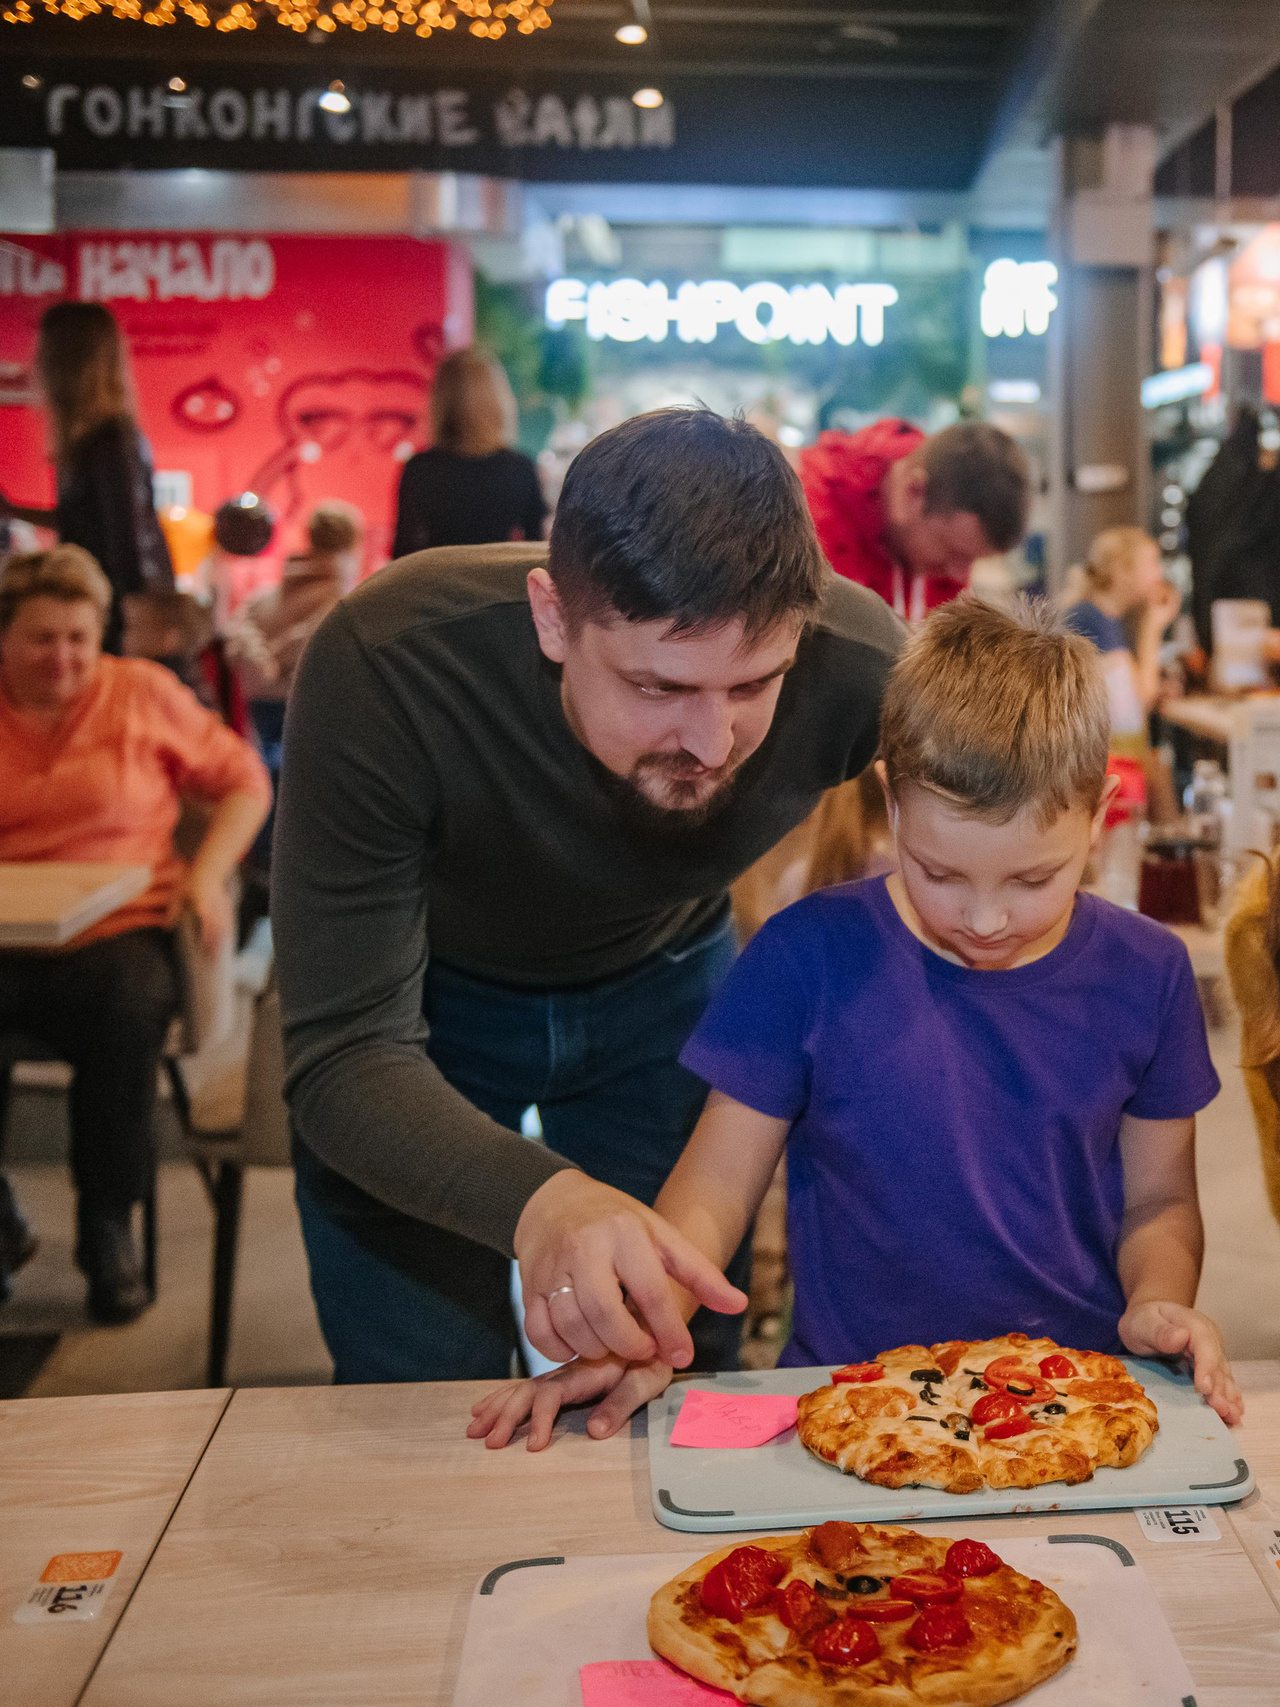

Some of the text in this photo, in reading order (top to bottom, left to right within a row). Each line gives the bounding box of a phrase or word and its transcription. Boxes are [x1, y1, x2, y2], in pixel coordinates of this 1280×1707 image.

[47, 84, 479, 146] ГОНКОНГСКИЕ
[545, 278, 899, 347] FISHPOINT
[1164, 1510, 1200, 1535] 115
[47, 1585, 88, 1613] 116
